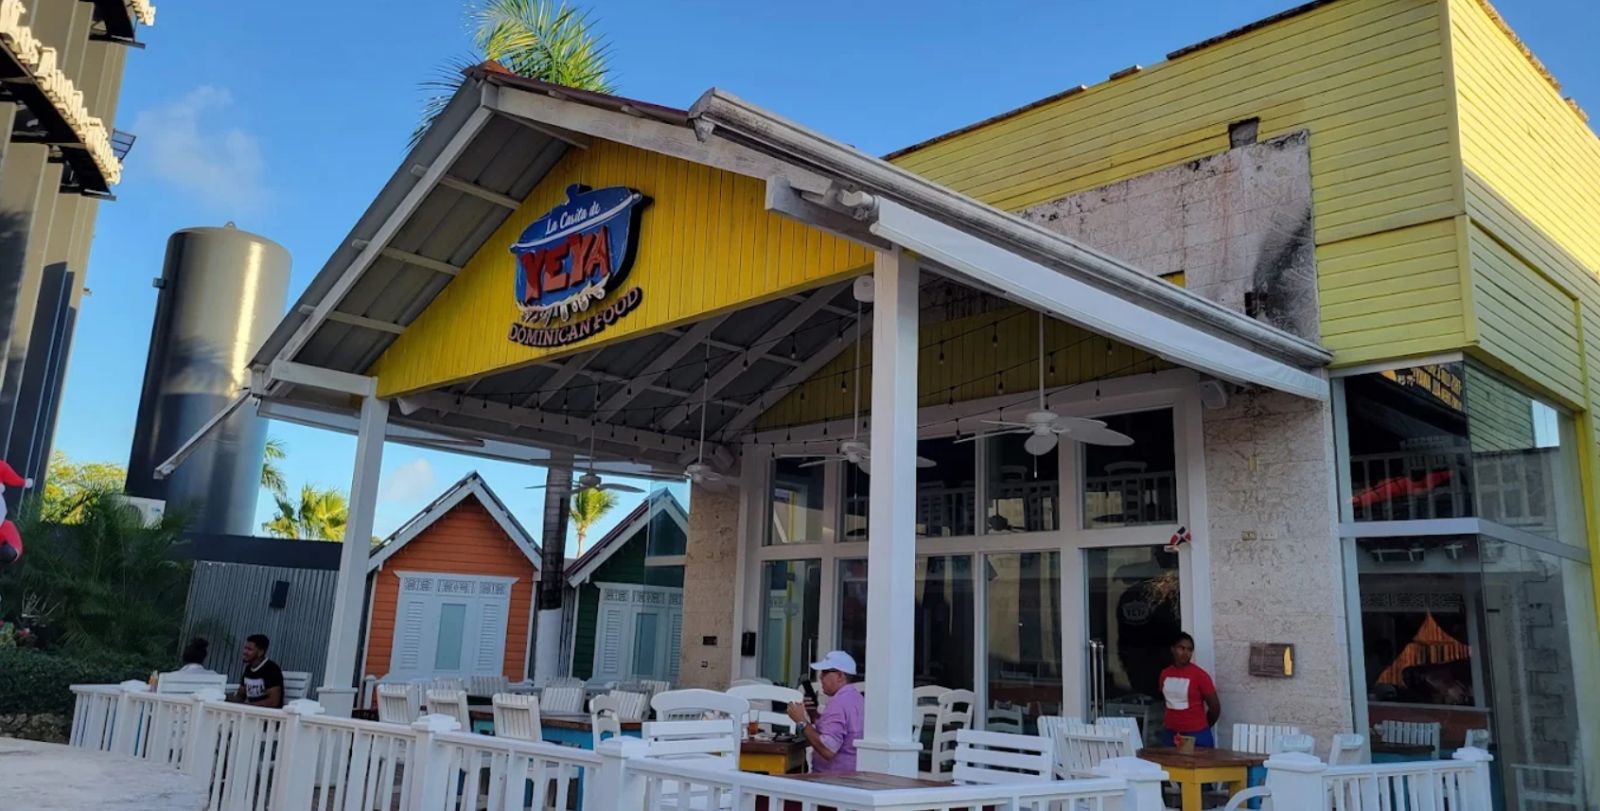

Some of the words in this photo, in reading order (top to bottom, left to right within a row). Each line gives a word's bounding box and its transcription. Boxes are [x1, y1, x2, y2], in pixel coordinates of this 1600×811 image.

[545, 218, 558, 235] La
[560, 207, 587, 229] Casita
[589, 201, 601, 217] de
[520, 225, 611, 302] YEYA
[509, 321, 591, 346] DOMINICAN
[593, 289, 640, 329] FOOD
